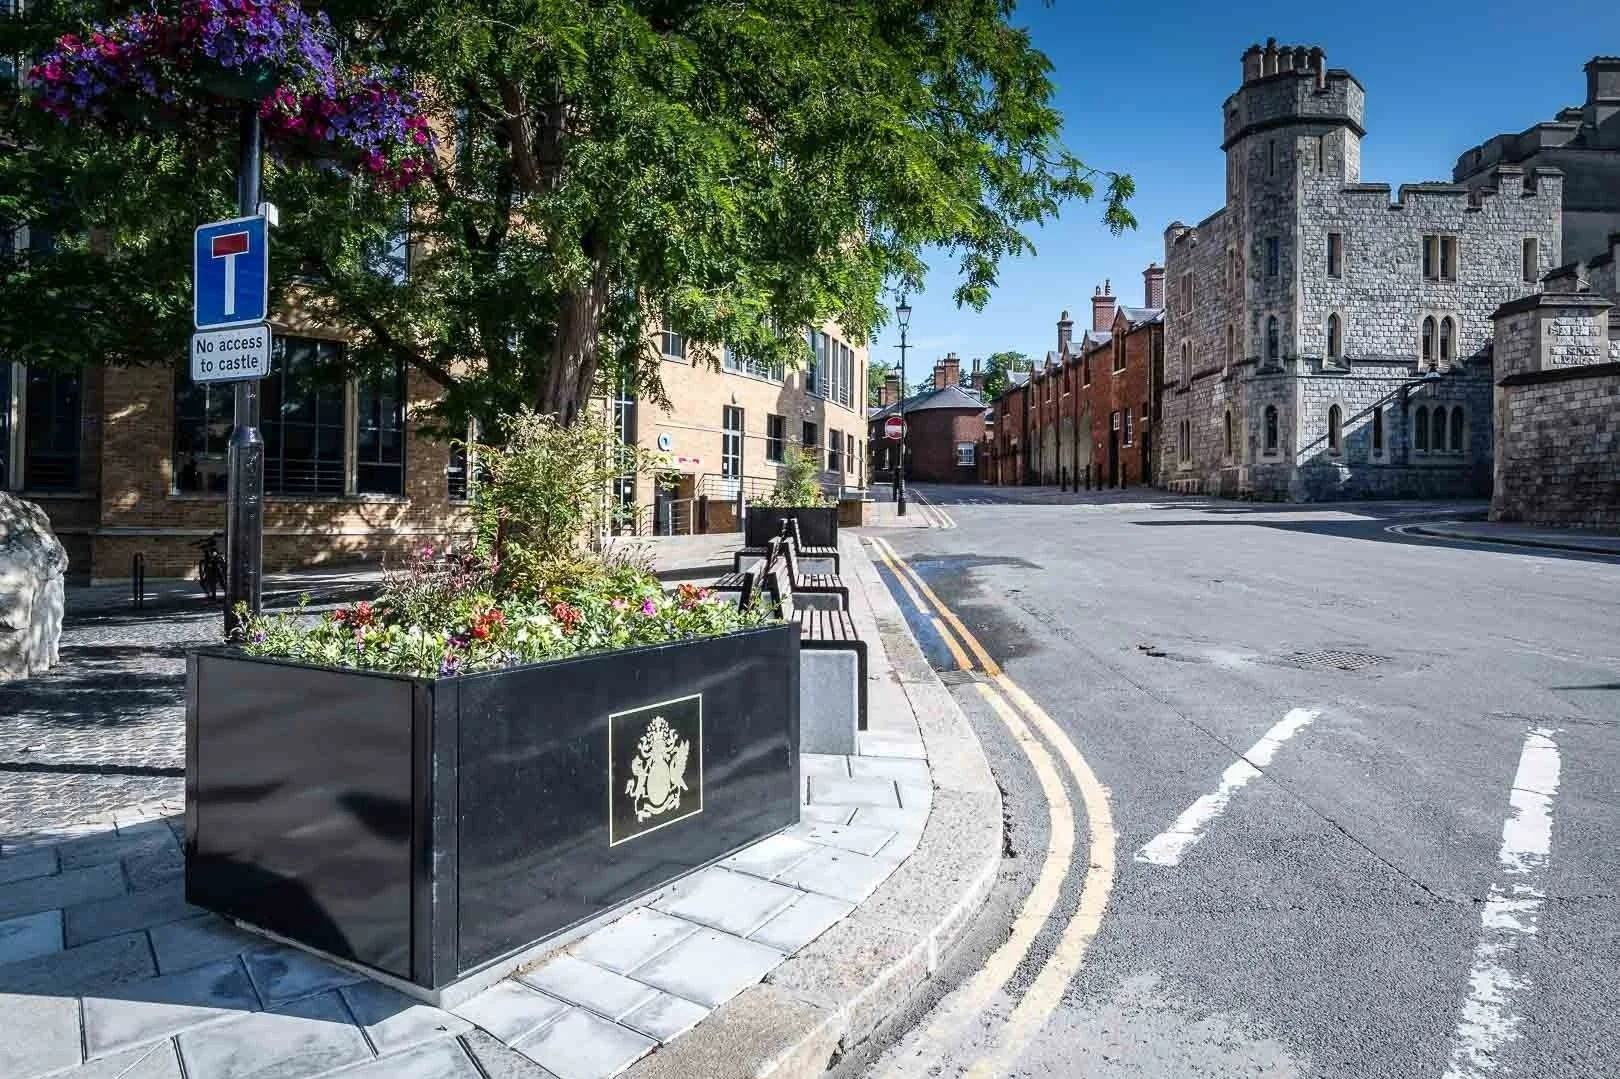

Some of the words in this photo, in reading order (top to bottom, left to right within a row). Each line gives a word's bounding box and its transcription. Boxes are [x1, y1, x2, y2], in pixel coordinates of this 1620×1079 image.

[196, 339, 214, 354] No
[219, 336, 263, 351] access
[201, 359, 214, 372] to
[219, 354, 258, 370] castle
